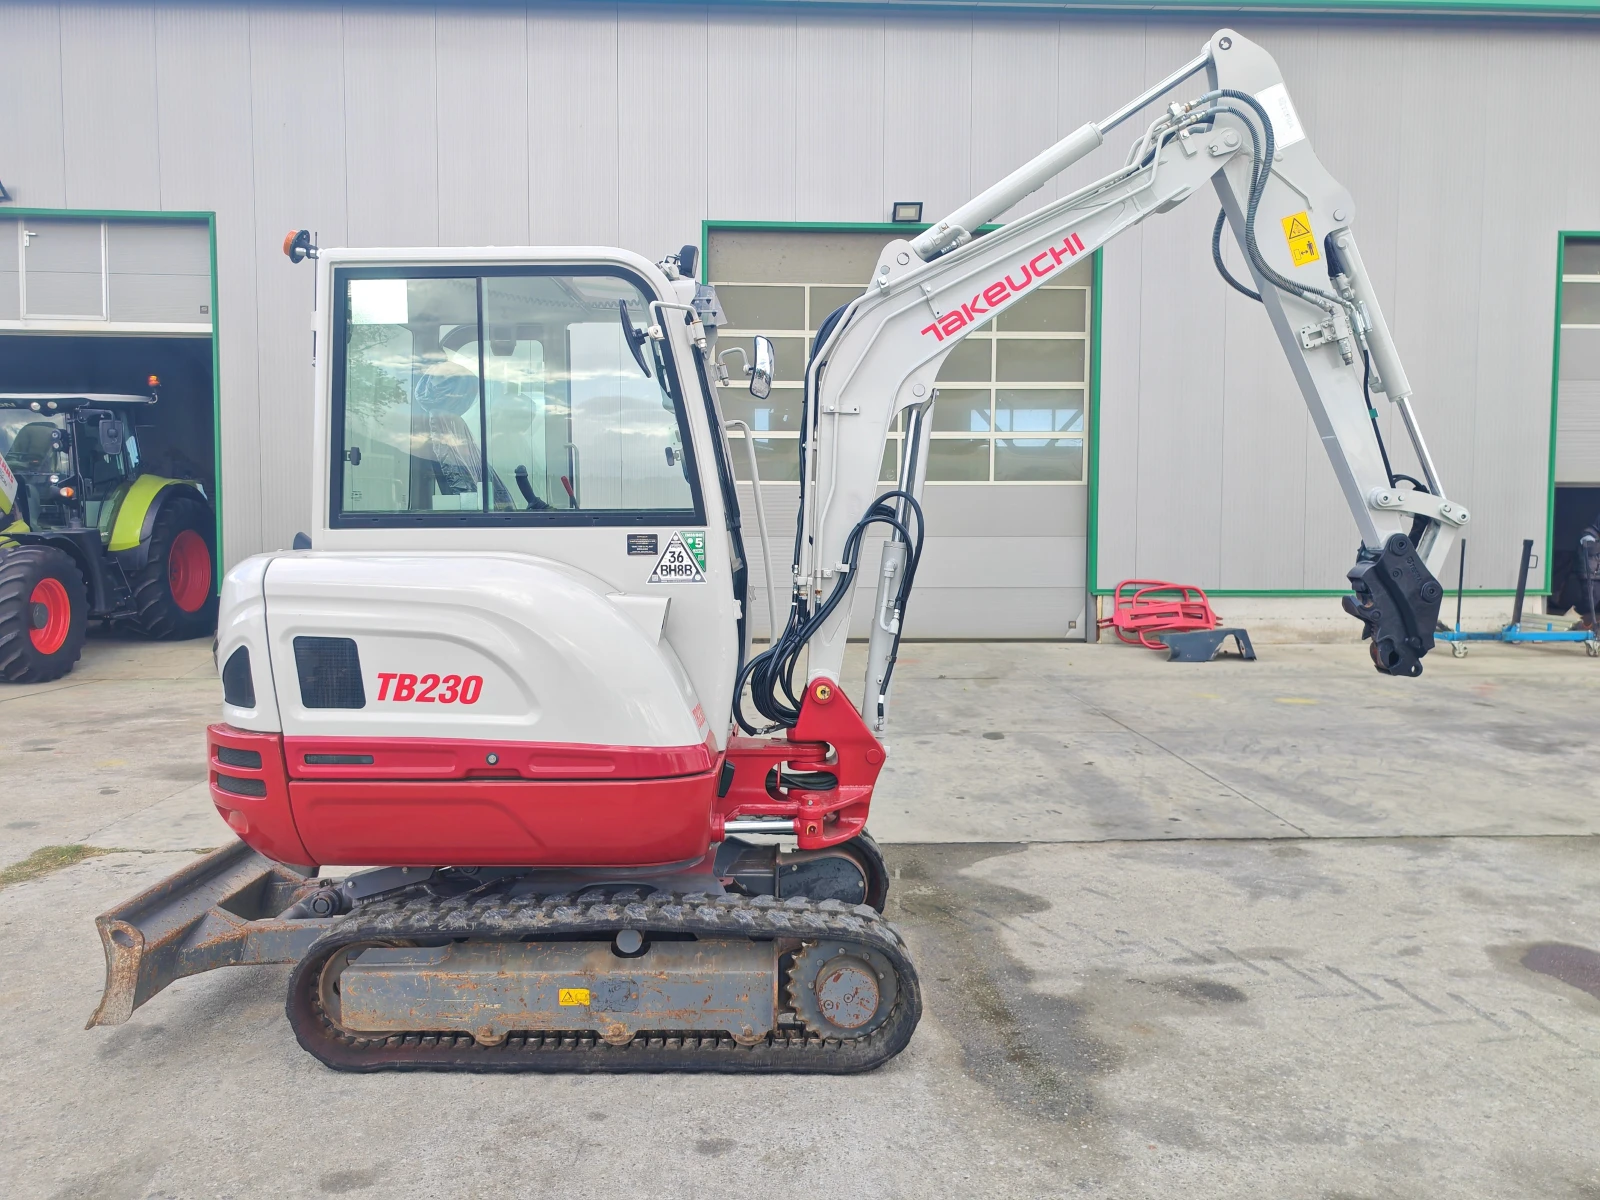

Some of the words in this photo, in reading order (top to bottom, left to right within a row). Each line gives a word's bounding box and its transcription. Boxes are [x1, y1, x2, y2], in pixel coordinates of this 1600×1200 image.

[695, 538, 703, 548] 5
[668, 550, 684, 564] 36
[660, 564, 693, 577] BH8B
[377, 672, 484, 705] TB230
